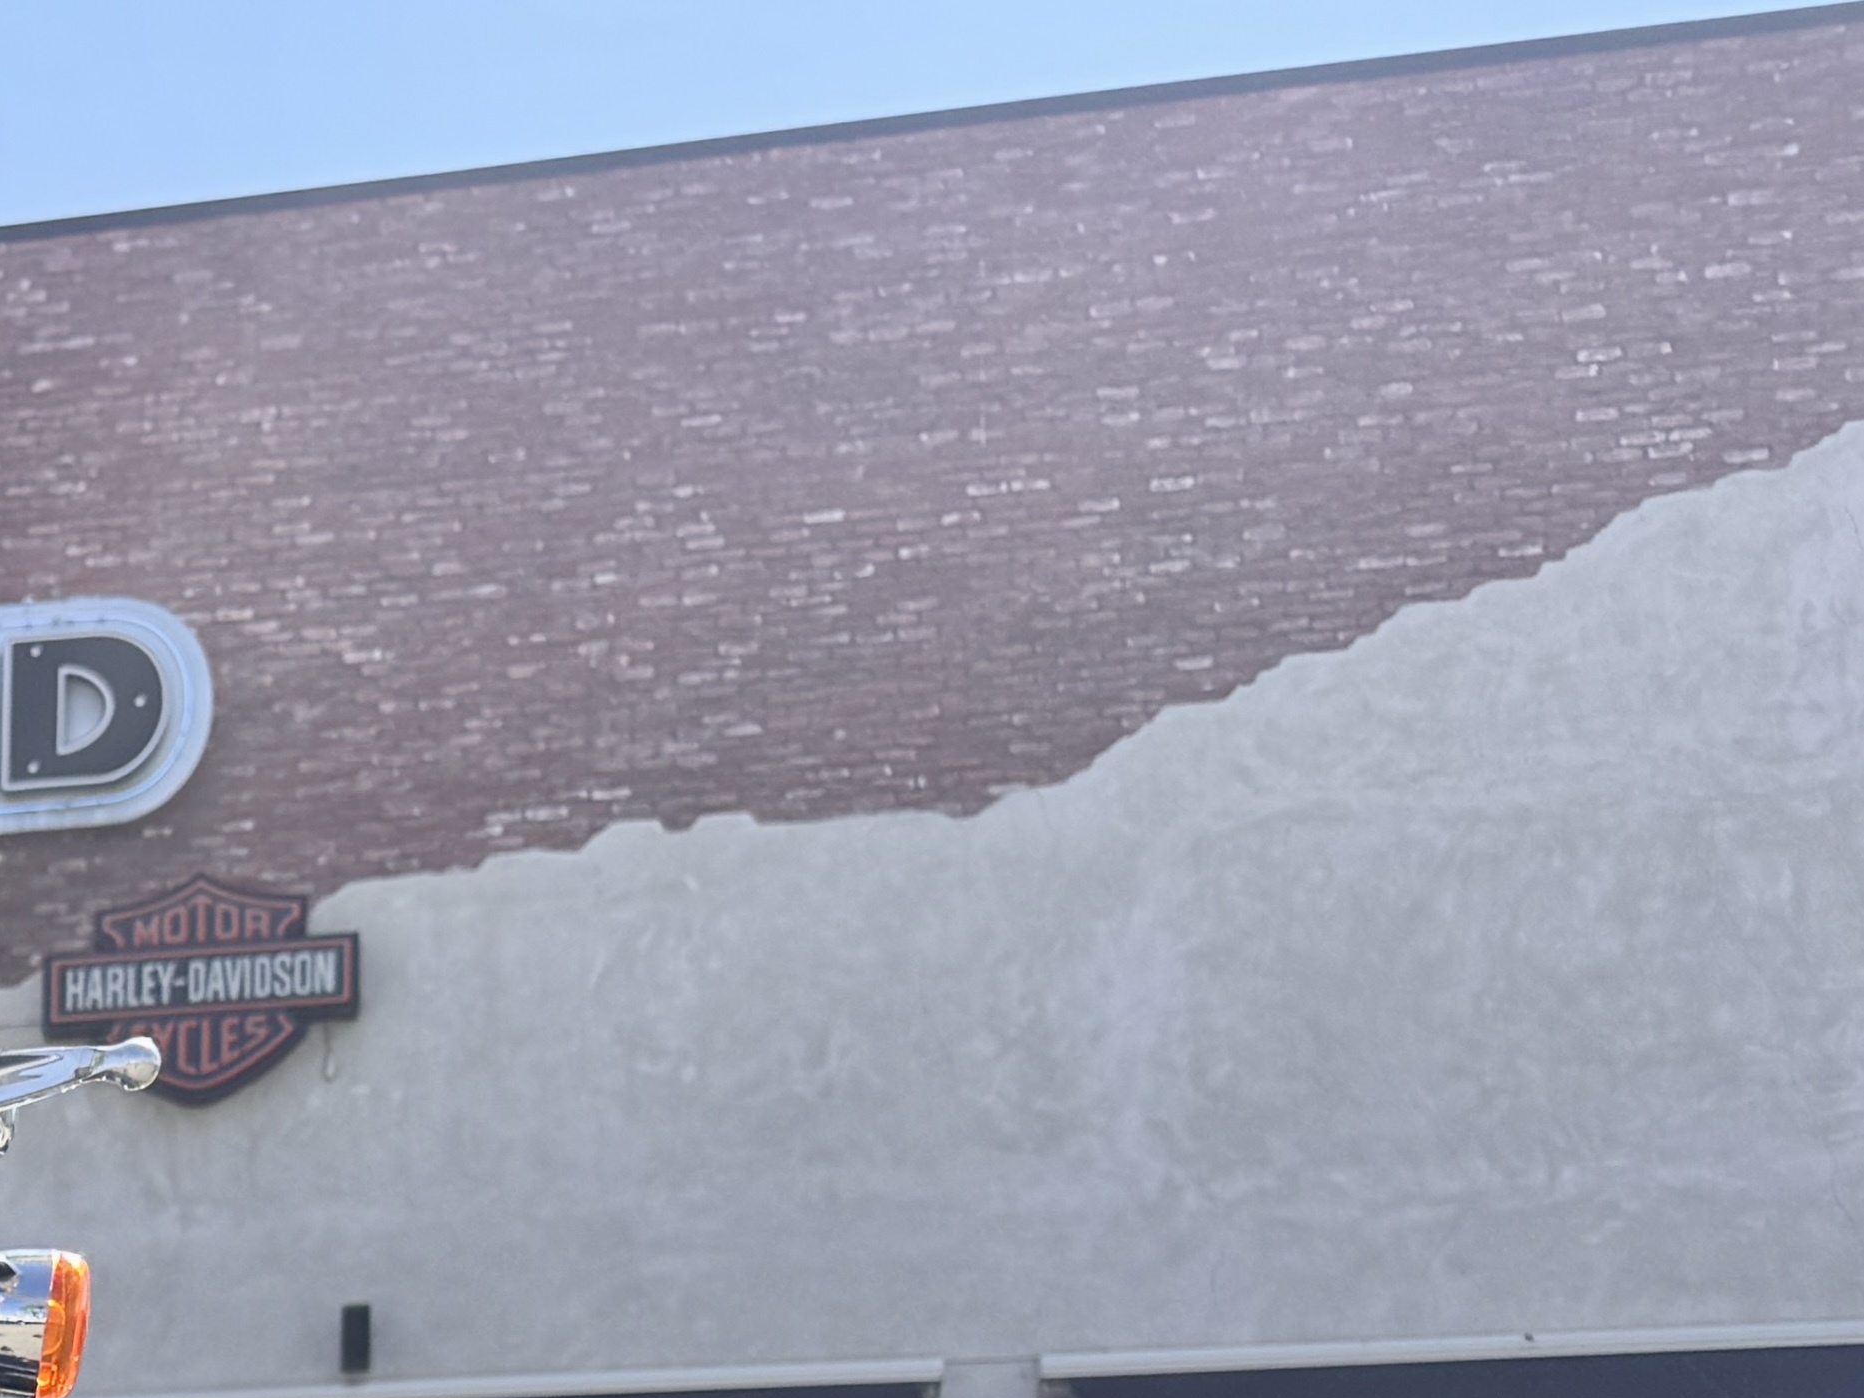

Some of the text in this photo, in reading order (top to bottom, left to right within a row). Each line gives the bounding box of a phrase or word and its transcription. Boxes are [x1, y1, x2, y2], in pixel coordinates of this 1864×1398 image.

[133, 899, 270, 948] MOTOR
[64, 951, 337, 1012] HARLEY-DAVIDSON
[131, 1015, 269, 1076] YCLES
